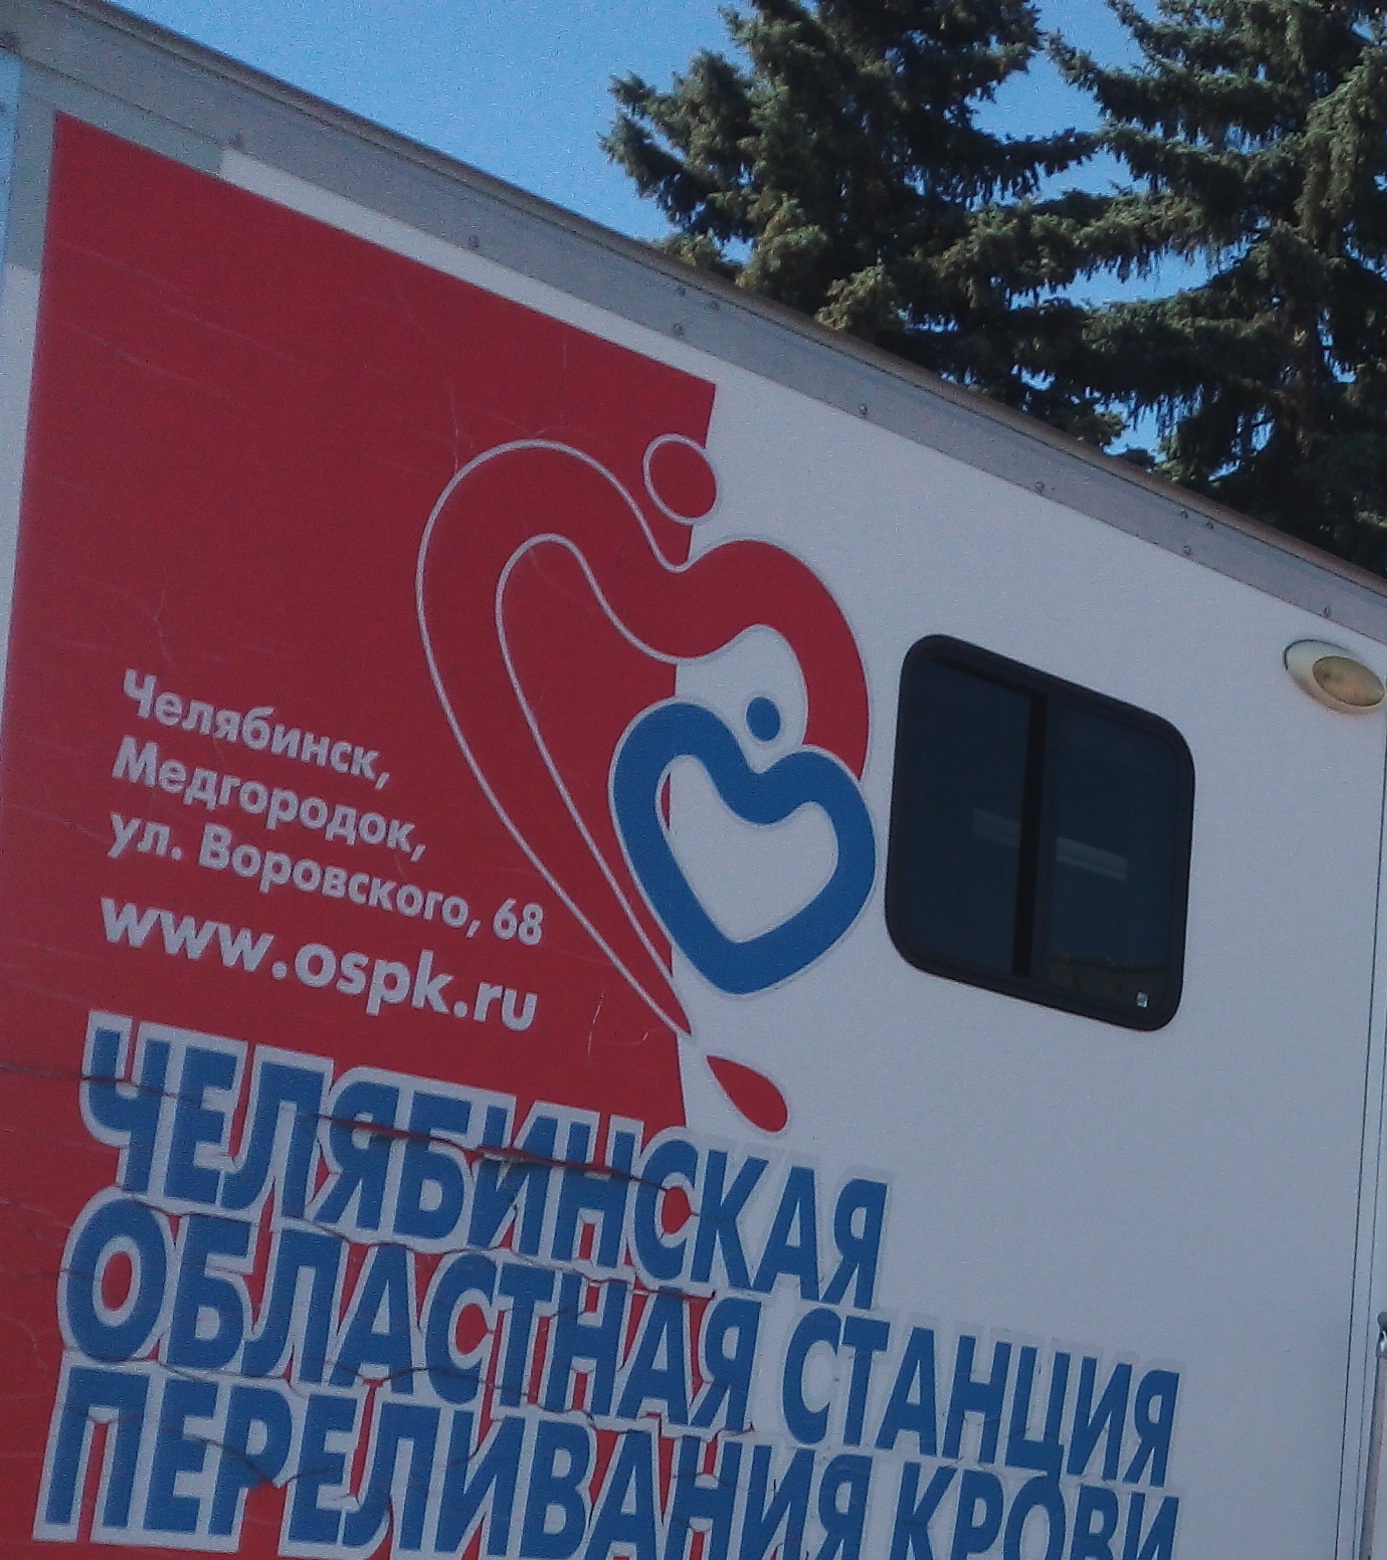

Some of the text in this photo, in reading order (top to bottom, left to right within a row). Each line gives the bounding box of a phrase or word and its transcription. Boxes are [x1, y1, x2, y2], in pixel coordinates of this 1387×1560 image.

[123, 668, 390, 788] Челябинск,
[112, 735, 427, 861] Медгородок,
[108, 812, 544, 946] ул. Воровского, 68
[101, 896, 538, 1032] www.ospk.ru
[86, 1026, 889, 1312] ЧЕЛЯБИНСКАЯ
[65, 1197, 1180, 1488] ОБЛАСТНАЯ СТАНЦИЯ
